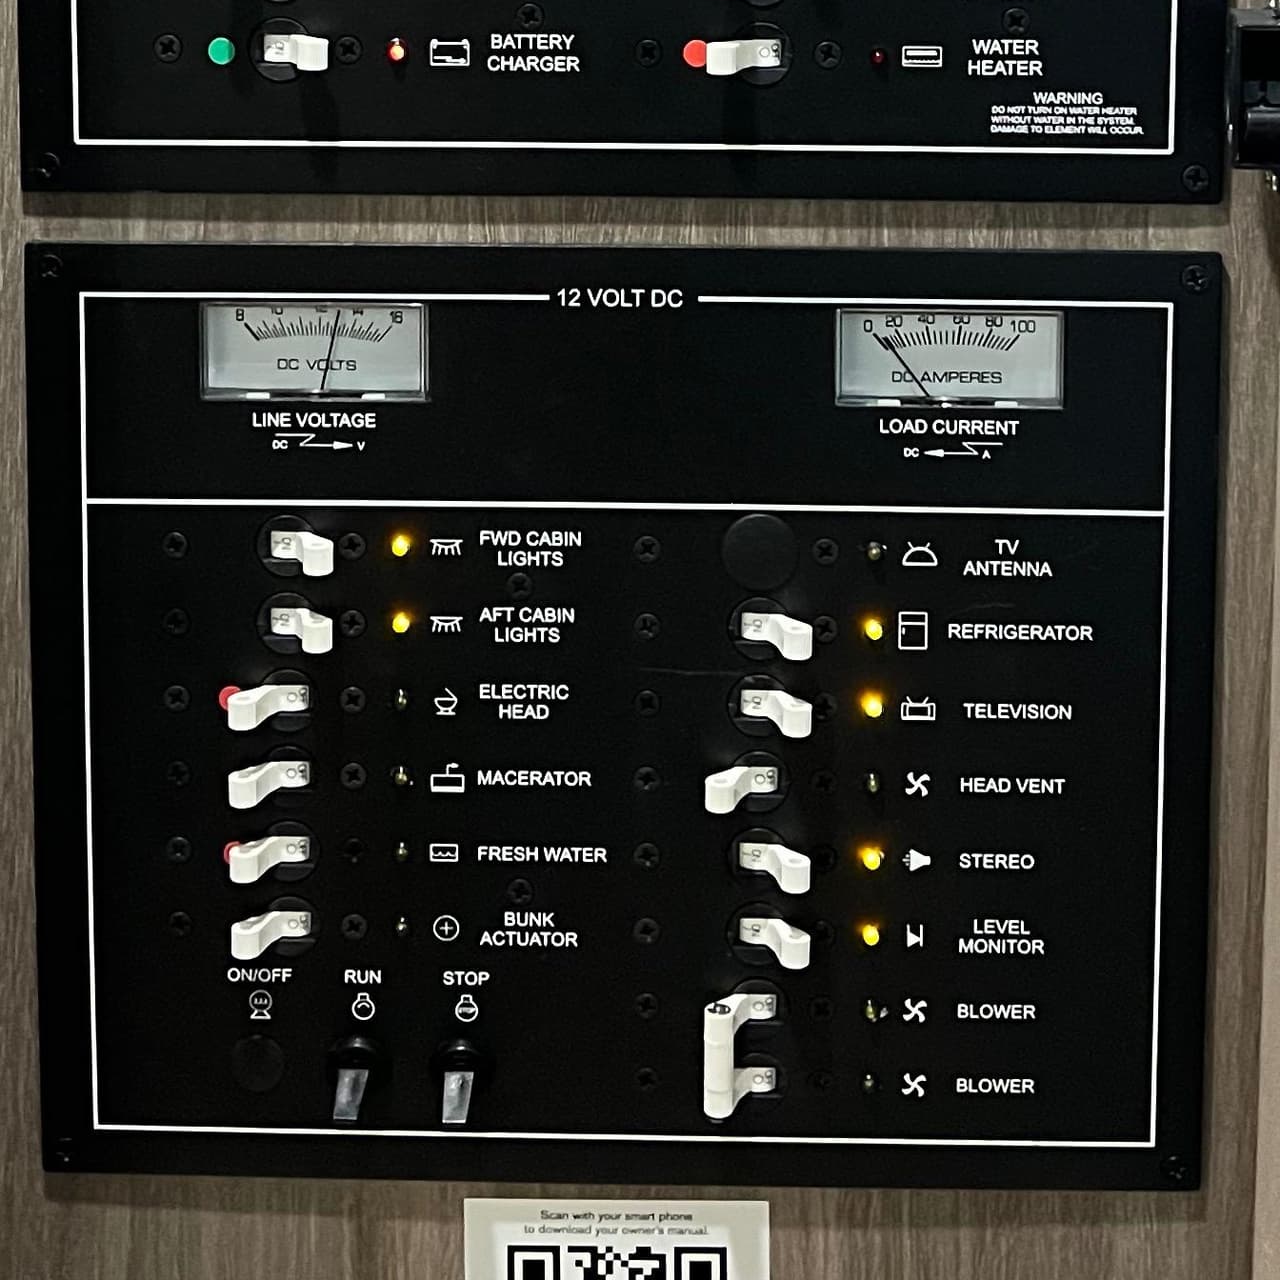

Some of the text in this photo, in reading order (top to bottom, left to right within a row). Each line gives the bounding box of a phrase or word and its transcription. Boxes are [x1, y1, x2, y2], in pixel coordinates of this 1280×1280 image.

[491, 34, 574, 49] BATTERY
[972, 39, 1038, 55] WATER
[488, 56, 579, 71] CHARGER
[968, 60, 1042, 75] HEATER
[1033, 92, 1103, 104] WARNING
[558, 289, 682, 307] 12 VOLT DC
[235, 308, 245, 321] 8
[864, 320, 873, 332] 0
[885, 315, 902, 328] 20
[986, 315, 1003, 327] 80
[1010, 320, 1036, 333] 100
[277, 359, 357, 371] DC VOLTS
[892, 371, 1002, 384] DC AMPERES
[253, 413, 376, 428] LINE VOLTAGE
[880, 419, 1019, 435] LOAD CURRENT
[272, 440, 366, 451] DC V
[903, 448, 991, 459] DC A
[480, 530, 581, 546] FWD CABIN
[995, 539, 1019, 554] TV
[498, 551, 563, 566] LIGHTS
[964, 561, 1052, 576] ANTENNA
[480, 607, 574, 623] AFT CABIN
[495, 627, 560, 642] LIGHTS
[949, 624, 1092, 640] REFRIGERATOR
[480, 684, 569, 699] ELECTRIC
[499, 704, 549, 719] HEAD
[964, 703, 1071, 719] TELEVISION
[478, 770, 591, 786] MACERATOR
[961, 778, 1065, 794] HEAD VENT
[478, 846, 607, 862] FRESH WATER
[960, 853, 1034, 869] STEREO
[505, 912, 554, 927] BUNK
[974, 919, 1030, 934] LEVEL
[480, 931, 577, 947] ACTUATOR
[959, 939, 1044, 954] MONITOR
[228, 968, 292, 982] ON/OFF
[345, 970, 381, 984] RUN
[443, 971, 489, 985] STOP
[958, 1004, 1035, 1019] BLOWER
[957, 1078, 1034, 1093] BLOWER
[540, 1210, 693, 1223] Scan with your smart phone
[524, 1225, 535, 1234] to
[538, 1225, 592, 1234] download
[595, 1226, 619, 1237] your
